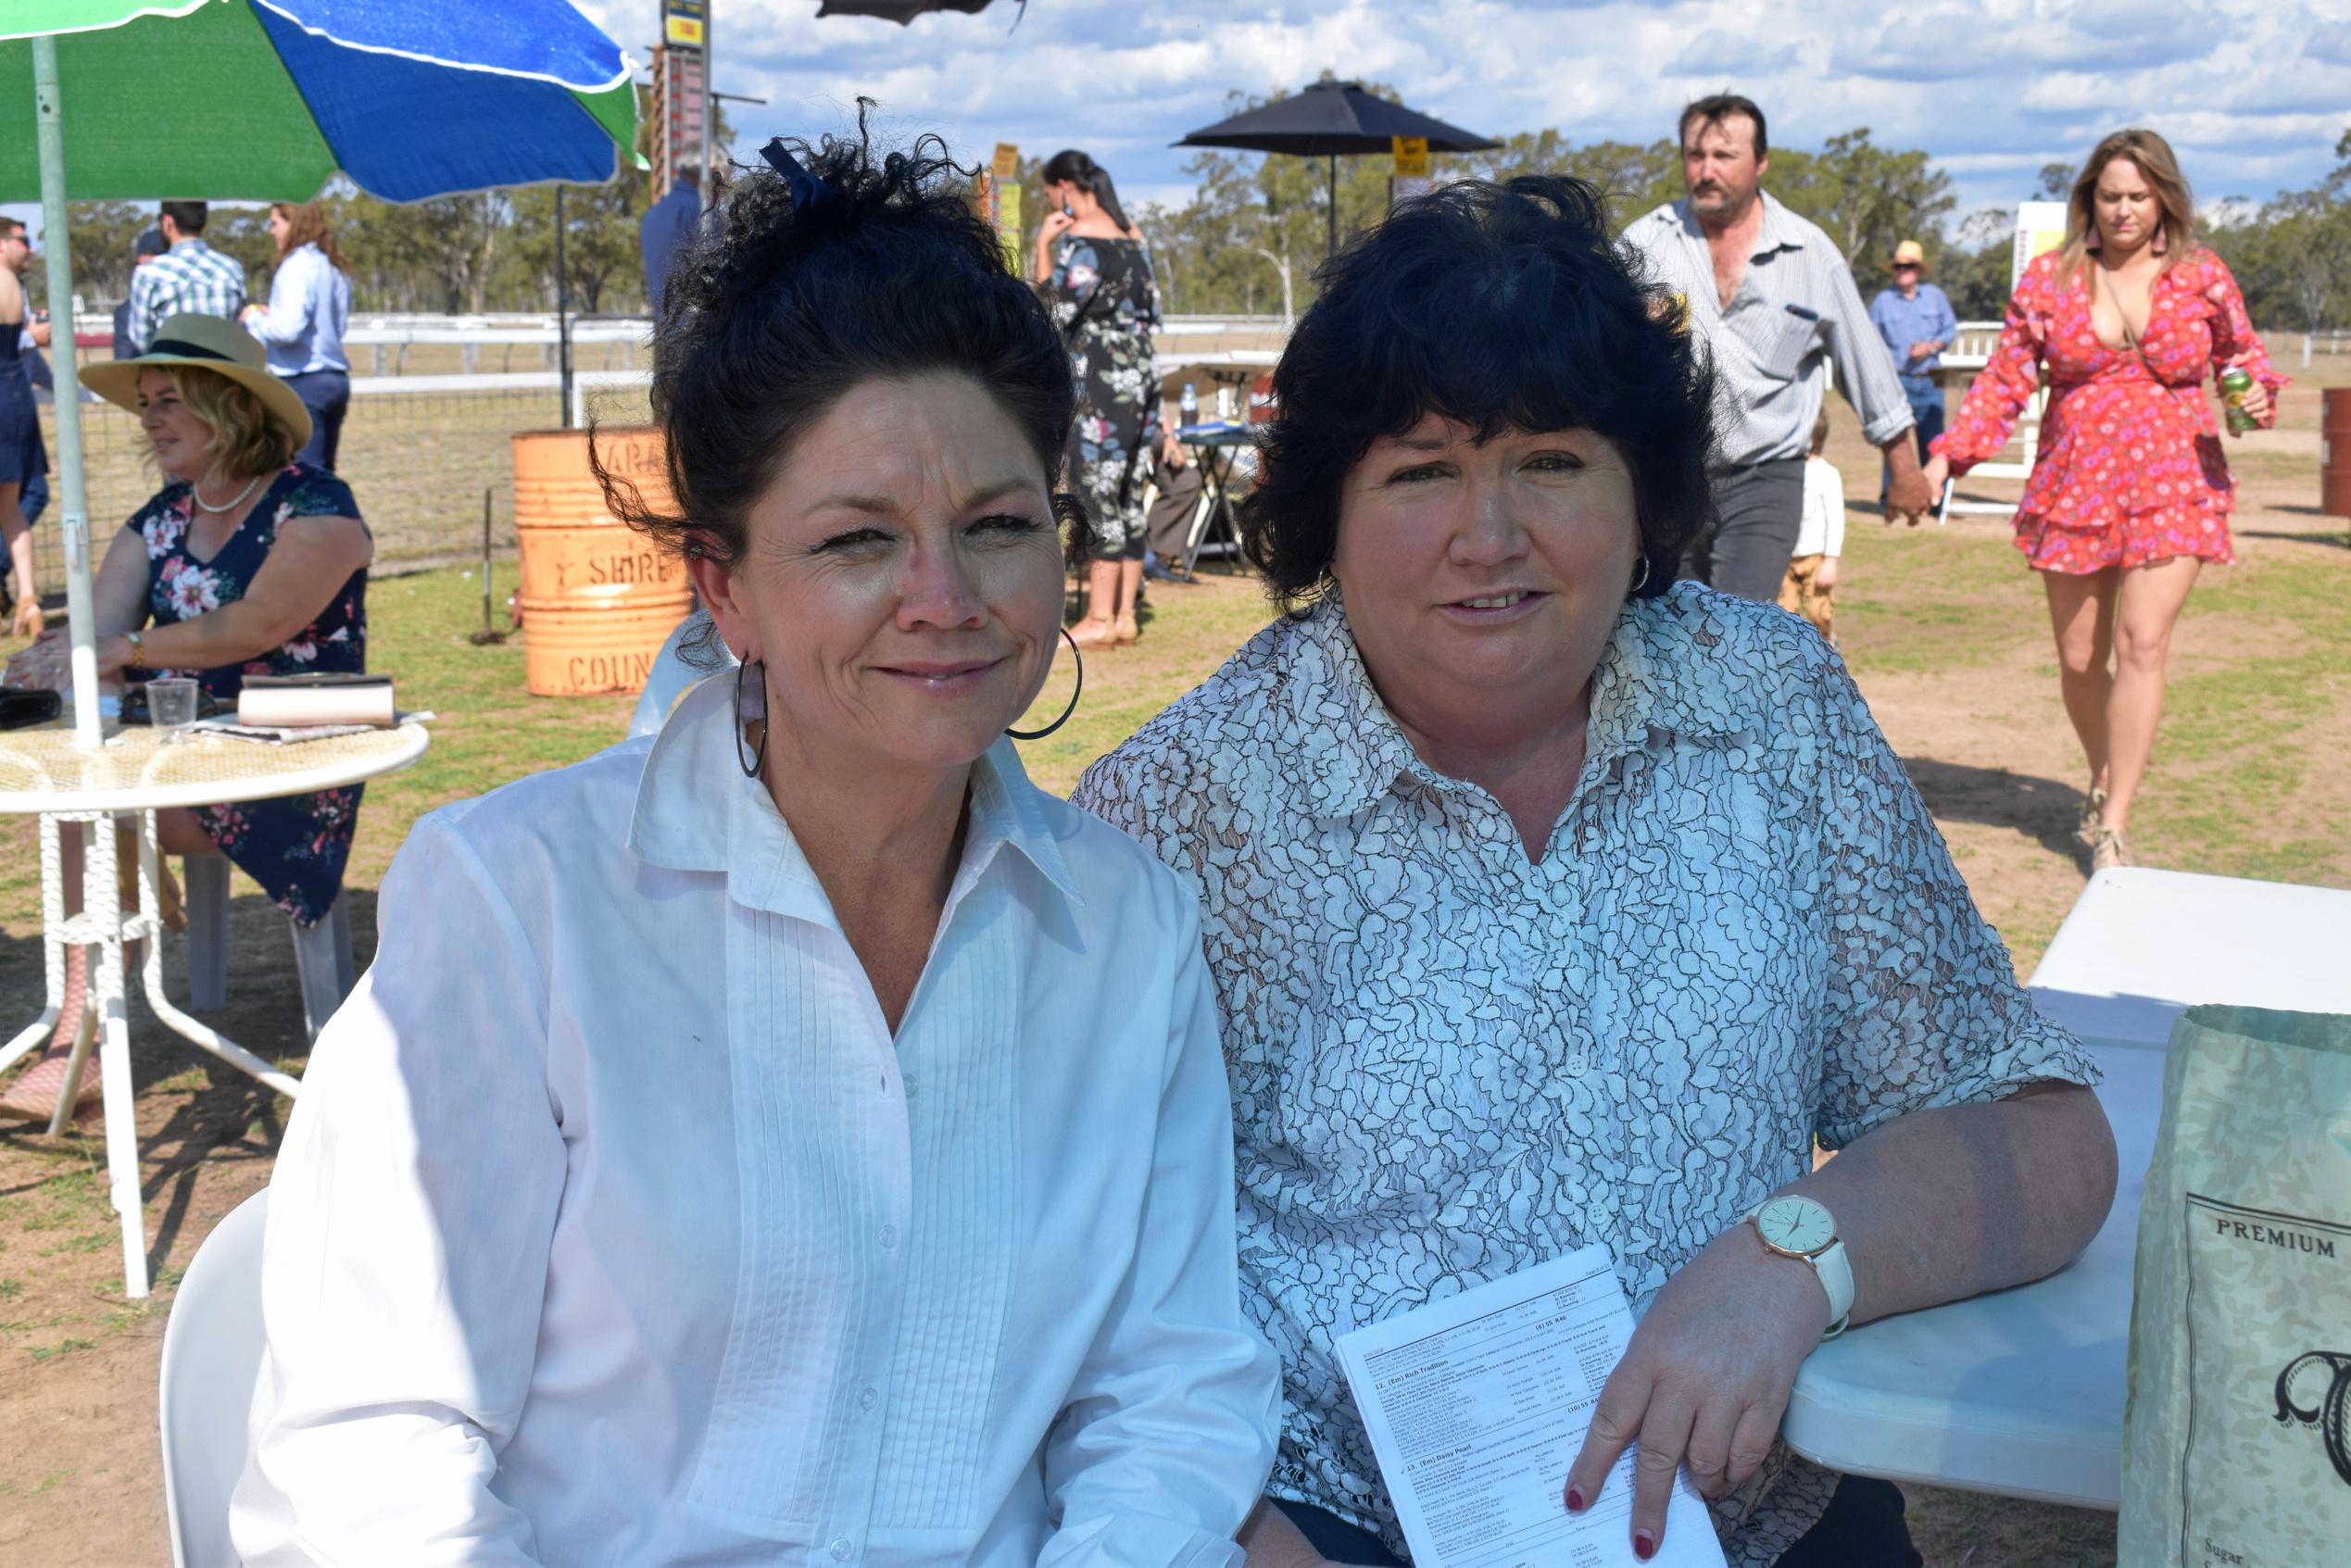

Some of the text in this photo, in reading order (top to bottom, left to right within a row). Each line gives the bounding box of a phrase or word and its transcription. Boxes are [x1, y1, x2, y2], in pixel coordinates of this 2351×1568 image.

[588, 553, 669, 584] SHIRE
[2216, 1218, 2336, 1259] PREMIUM
[1375, 1382, 1386, 1390] 12.
[1388, 1375, 1404, 1386] (Em)
[1405, 1370, 1419, 1379] Rich
[1420, 1360, 1449, 1374] Tradition
[1407, 1463, 1417, 1472] 13.
[1419, 1457, 1436, 1468] (Em)
[1437, 1451, 1454, 1461] Daisy
[1454, 1444, 1472, 1454] Pearl
[2204, 1537, 2244, 1565] Sugar
